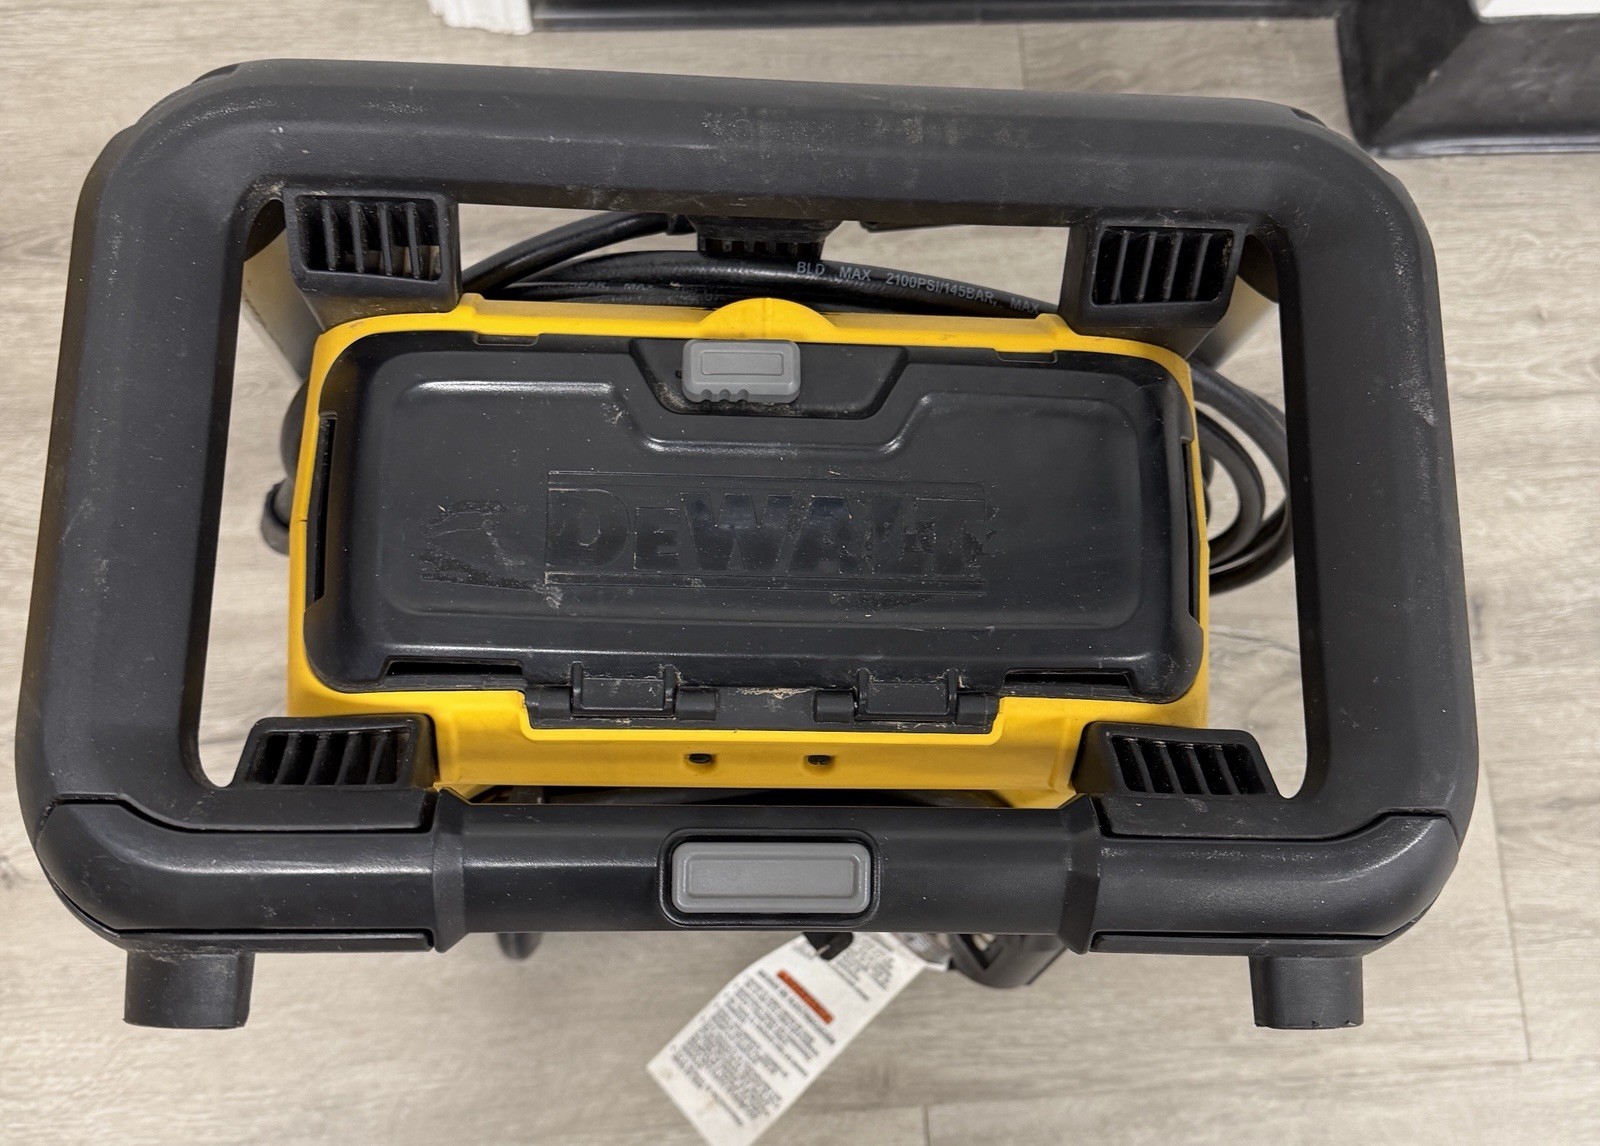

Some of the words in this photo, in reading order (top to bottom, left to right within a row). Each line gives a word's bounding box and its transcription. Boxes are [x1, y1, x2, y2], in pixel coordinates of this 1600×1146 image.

[796, 261, 825, 276] BLD
[839, 266, 872, 281] MAX
[885, 272, 998, 305] 2100PSI/145BAR,
[1010, 298, 1040, 314] MAX
